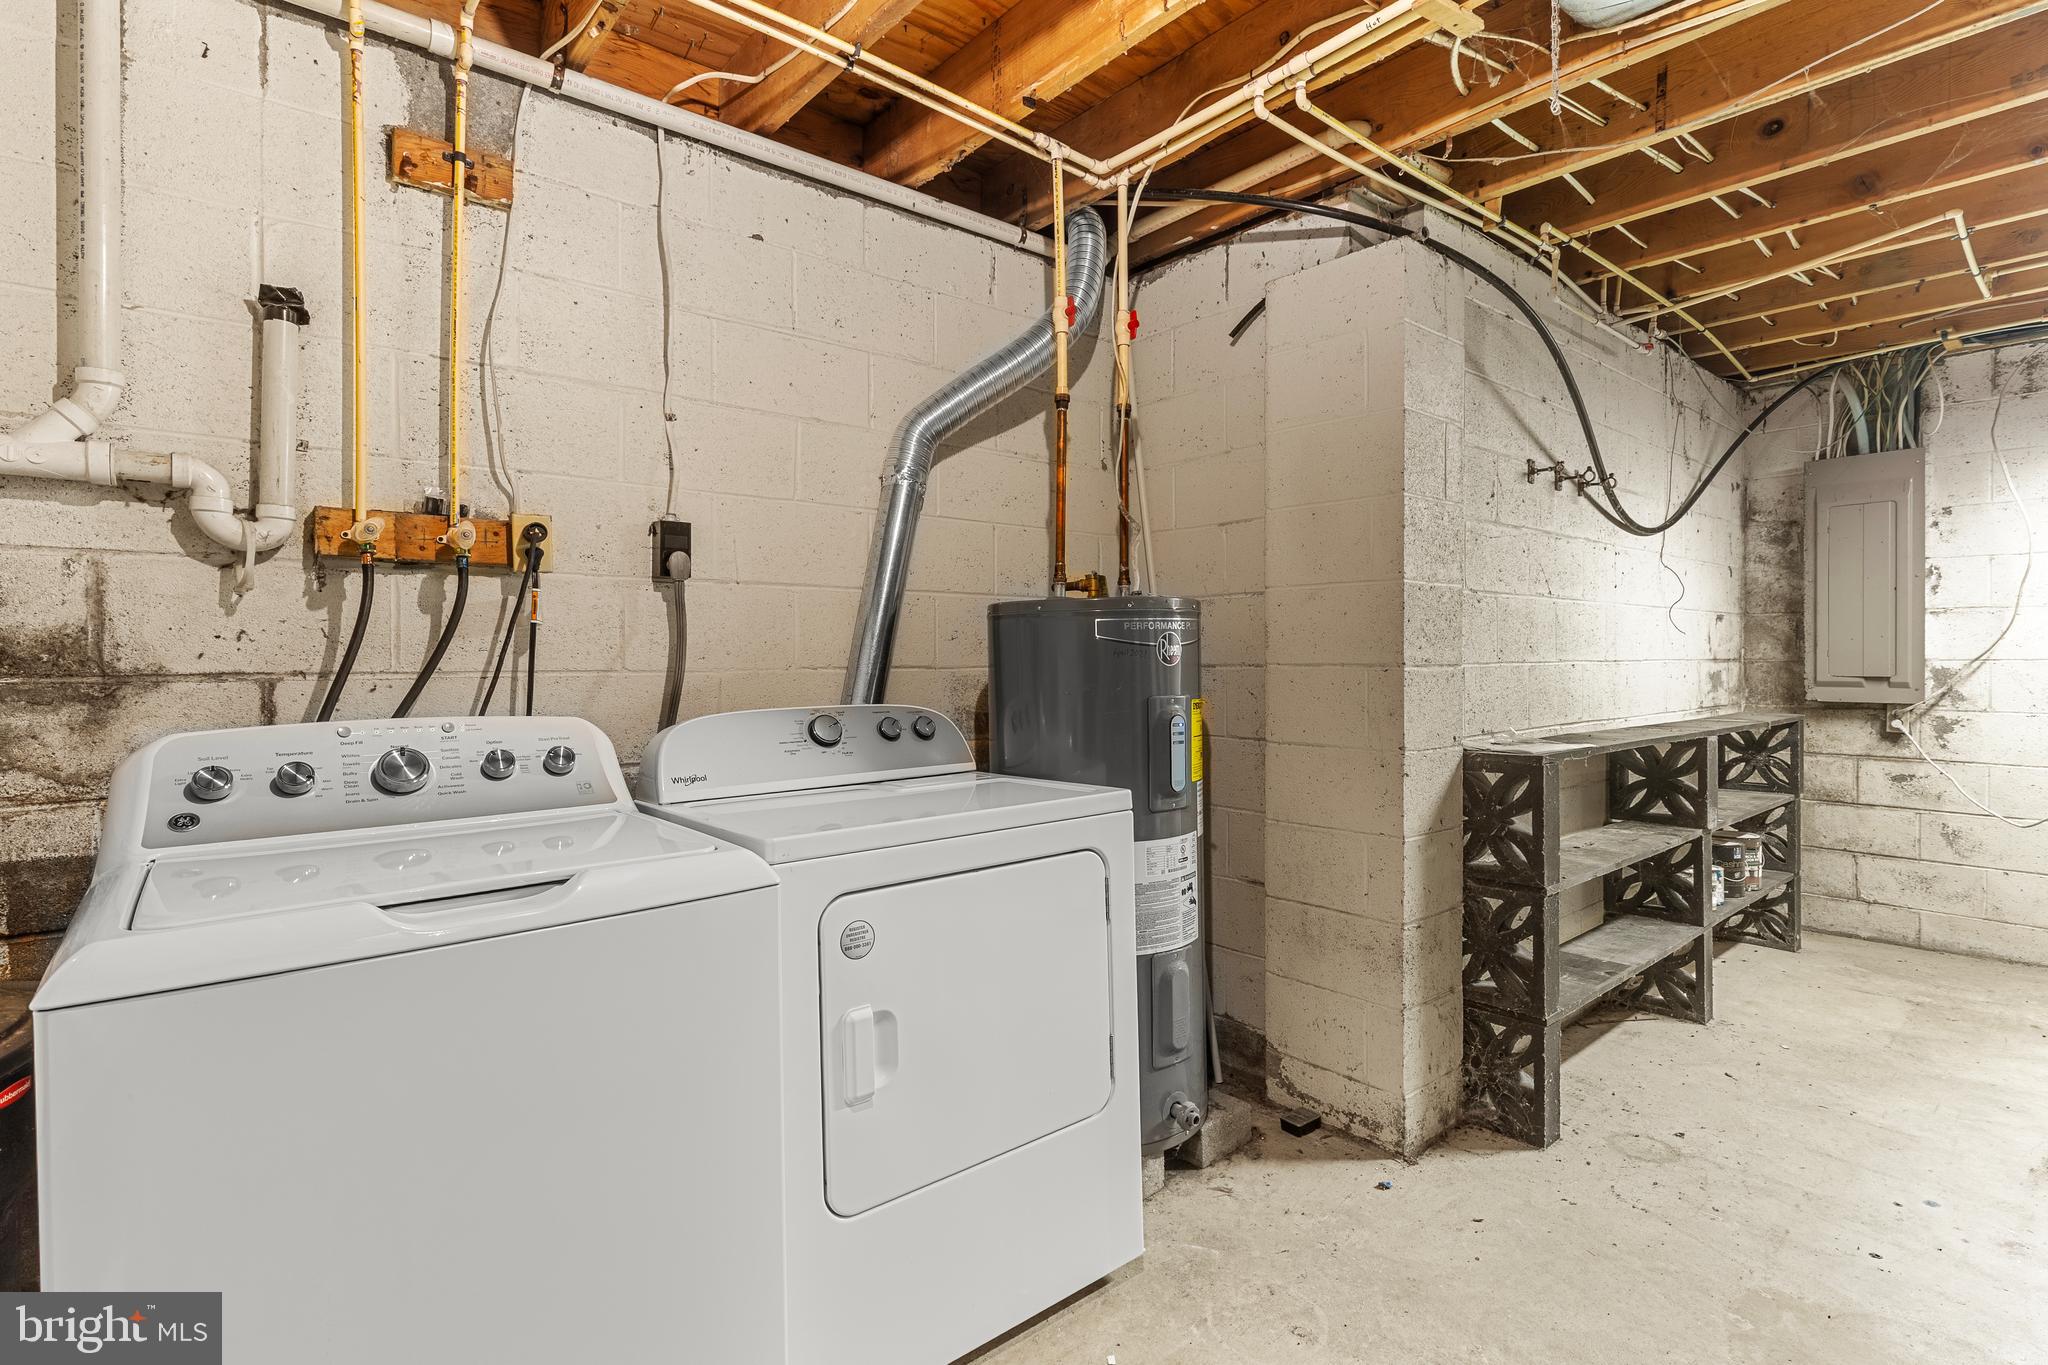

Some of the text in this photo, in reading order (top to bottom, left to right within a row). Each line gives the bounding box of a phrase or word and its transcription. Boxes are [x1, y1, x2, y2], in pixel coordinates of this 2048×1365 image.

[1365, 17, 1381, 30] Hot
[1123, 621, 1185, 630] PERFORMANCE
[670, 774, 708, 786] Whirlpool
[0, 1080, 31, 1104] ubbermaid
